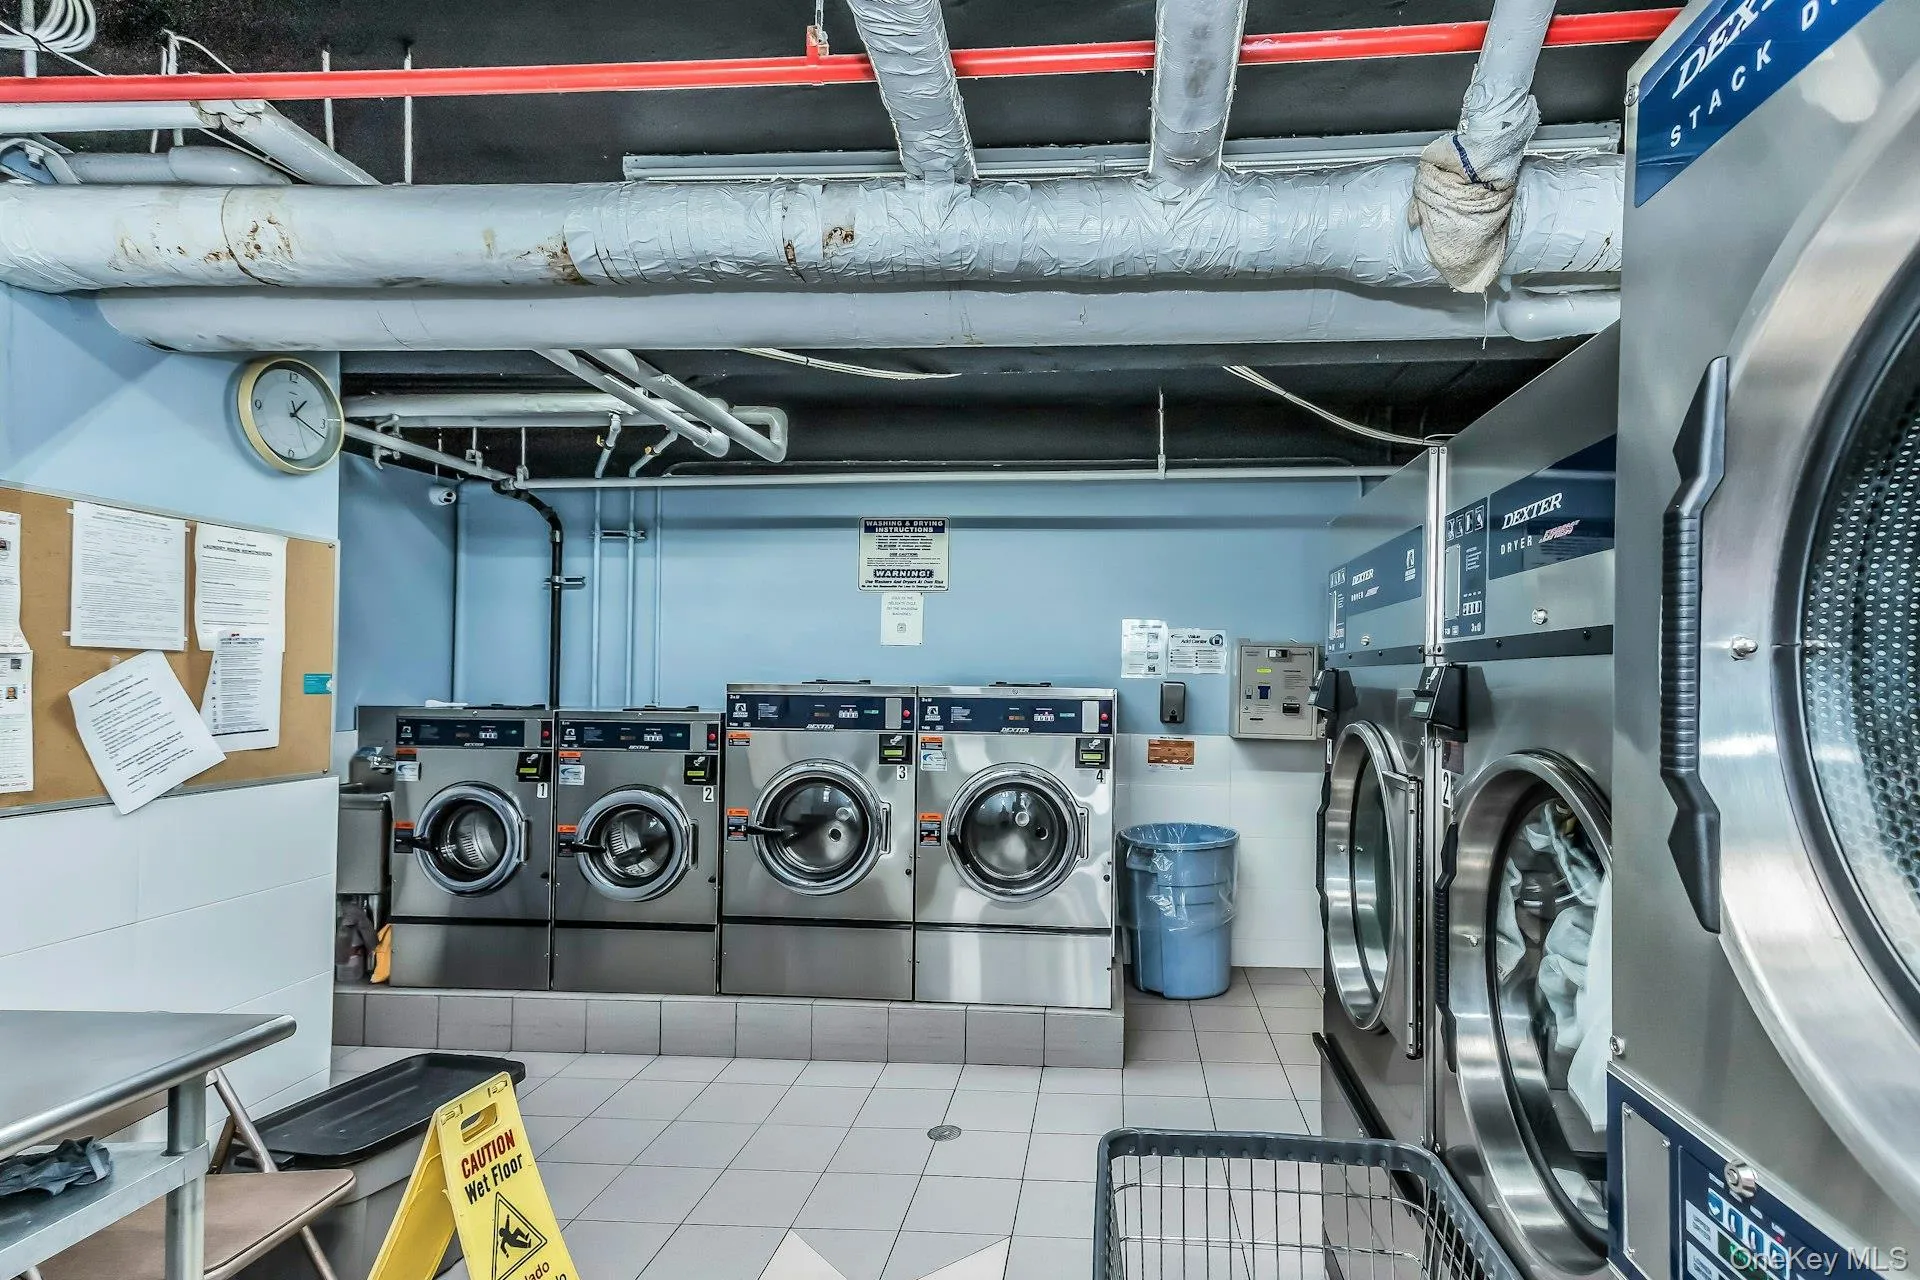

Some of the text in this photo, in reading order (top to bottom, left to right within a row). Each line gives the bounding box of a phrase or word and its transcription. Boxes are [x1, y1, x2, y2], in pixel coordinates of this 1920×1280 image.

[1672, 0, 1776, 99] DEX
[1670, 39, 1772, 148] STACK
[289, 373, 299, 384] 12
[254, 399, 262, 410] 9
[320, 418, 326, 429] 3
[288, 449, 295, 458] 6
[1501, 492, 1563, 530] DEXTER
[1500, 536, 1533, 555] DRYER
[1351, 568, 1374, 586] DEXTER
[898, 765, 906, 779] 3
[1096, 769, 1104, 782] 4
[540, 783, 545, 794] 1
[704, 787, 712, 801] 2
[1443, 771, 1450, 805] 2
[461, 1129, 516, 1179] CAUTION
[464, 1153, 523, 1205] Wet Floor
